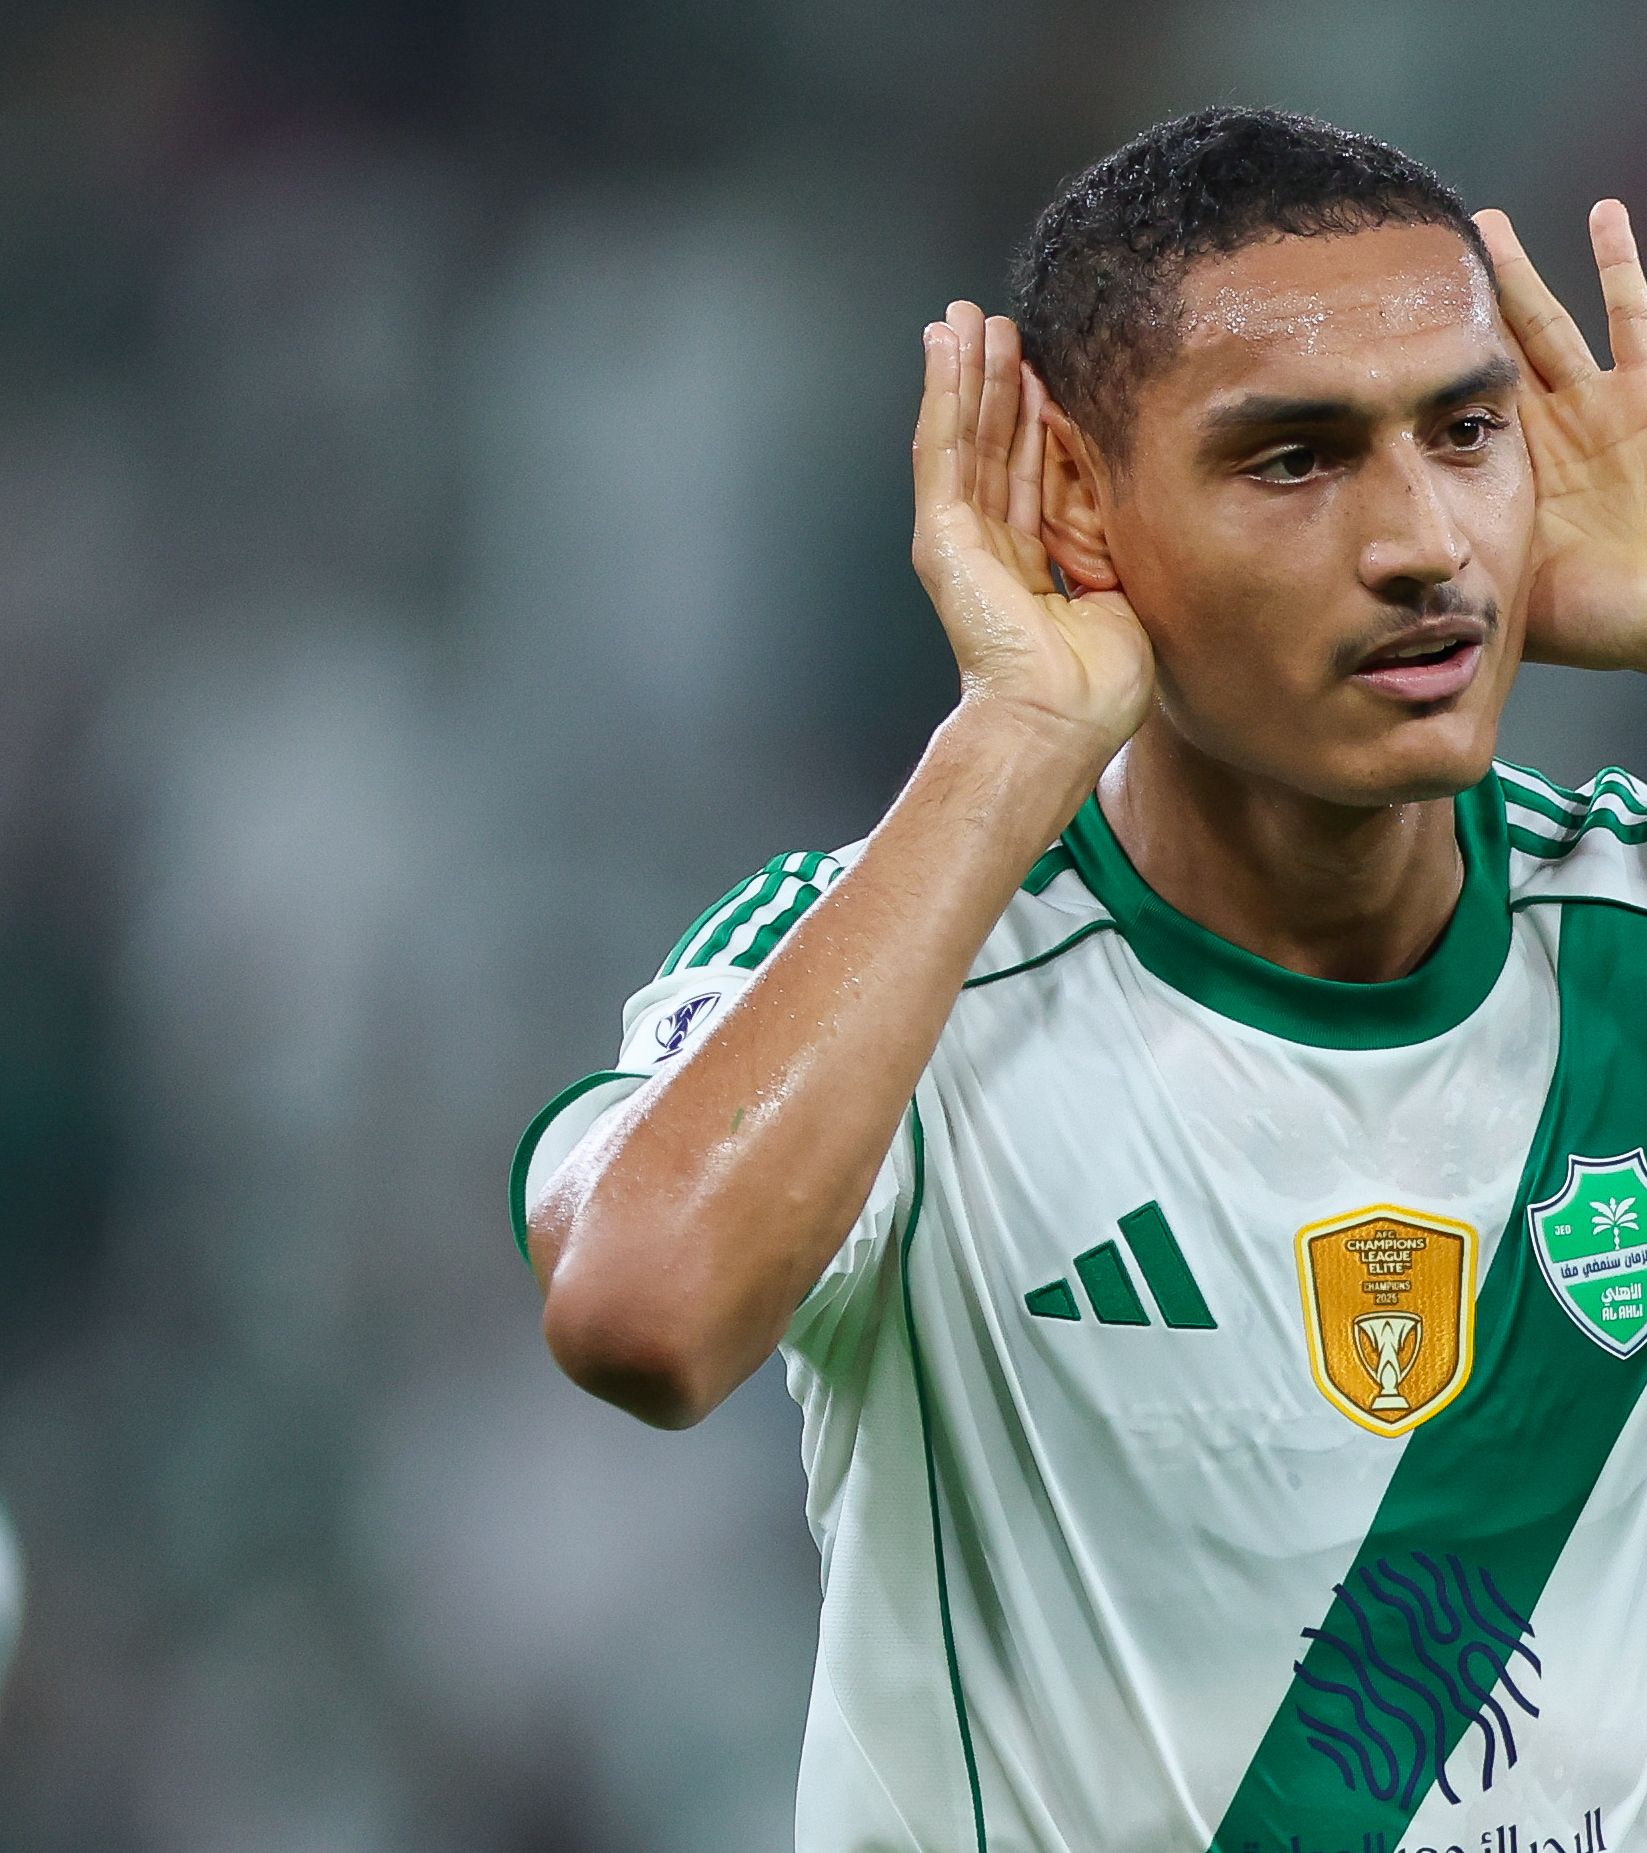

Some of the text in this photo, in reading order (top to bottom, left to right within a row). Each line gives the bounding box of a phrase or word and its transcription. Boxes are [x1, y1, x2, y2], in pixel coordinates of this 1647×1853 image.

[1375, 1230, 1395, 1239] AFC
[1554, 1225, 1572, 1235] JED
[1347, 1238, 1425, 1251] CHAMPIONS
[1361, 1250, 1411, 1262] LEAGUE
[1364, 1280, 1411, 1292] CHAMPIONS
[1375, 1292, 1398, 1304] 2025
[1602, 1303, 1643, 1321] AL AHLI
